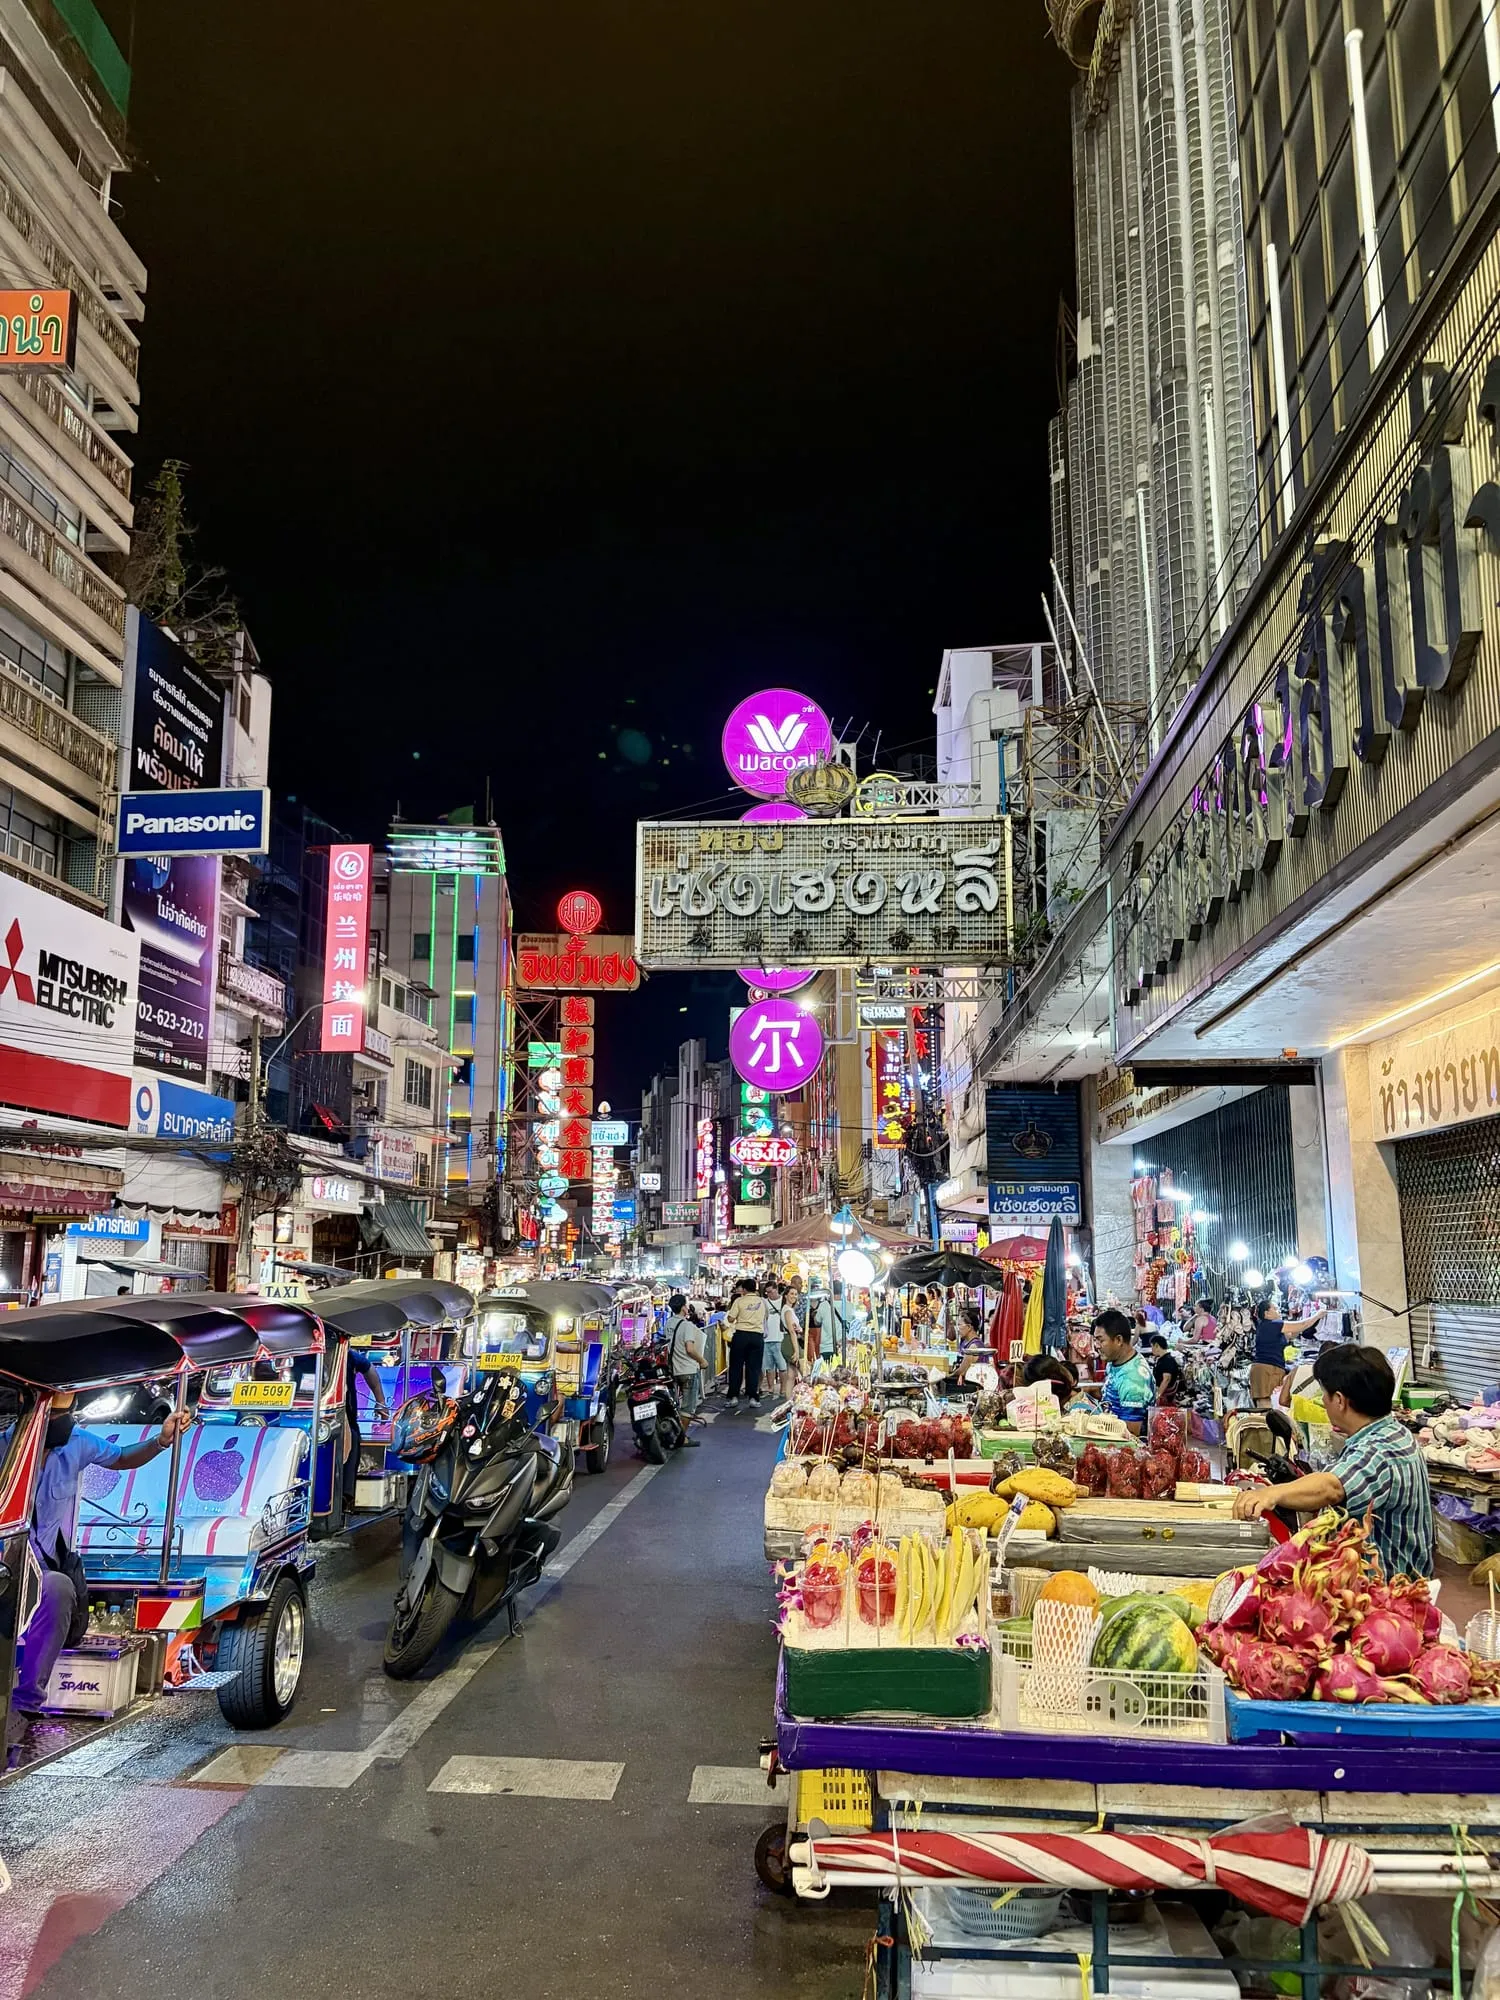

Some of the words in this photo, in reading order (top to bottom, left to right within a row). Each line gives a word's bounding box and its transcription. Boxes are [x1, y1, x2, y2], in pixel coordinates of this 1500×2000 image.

[739, 753, 816, 771] Wacoal
[126, 810, 255, 834] Panasonic
[699, 830, 783, 852] ทอง
[649, 837, 1001, 918] เซ่งเฮงหลี
[39, 949, 128, 1006] MITSUBISHI
[331, 915, 359, 1037] 兰州拉面
[37, 979, 115, 1029] ELECTRIC
[138, 1001, 205, 1041] 02-623-2212
[748, 1015, 804, 1073] 尔
[163, 1111, 232, 1143] ธนาคารทิสโก้
[997, 1185, 1025, 1195] ทอง
[993, 1196, 1077, 1213] เซ่งเฮงหลี
[266, 1286, 298, 1298] TAXI
[501, 1354, 520, 1363] 7307
[263, 1385, 291, 1397] 5097
[58, 1680, 100, 1692] SPARK
